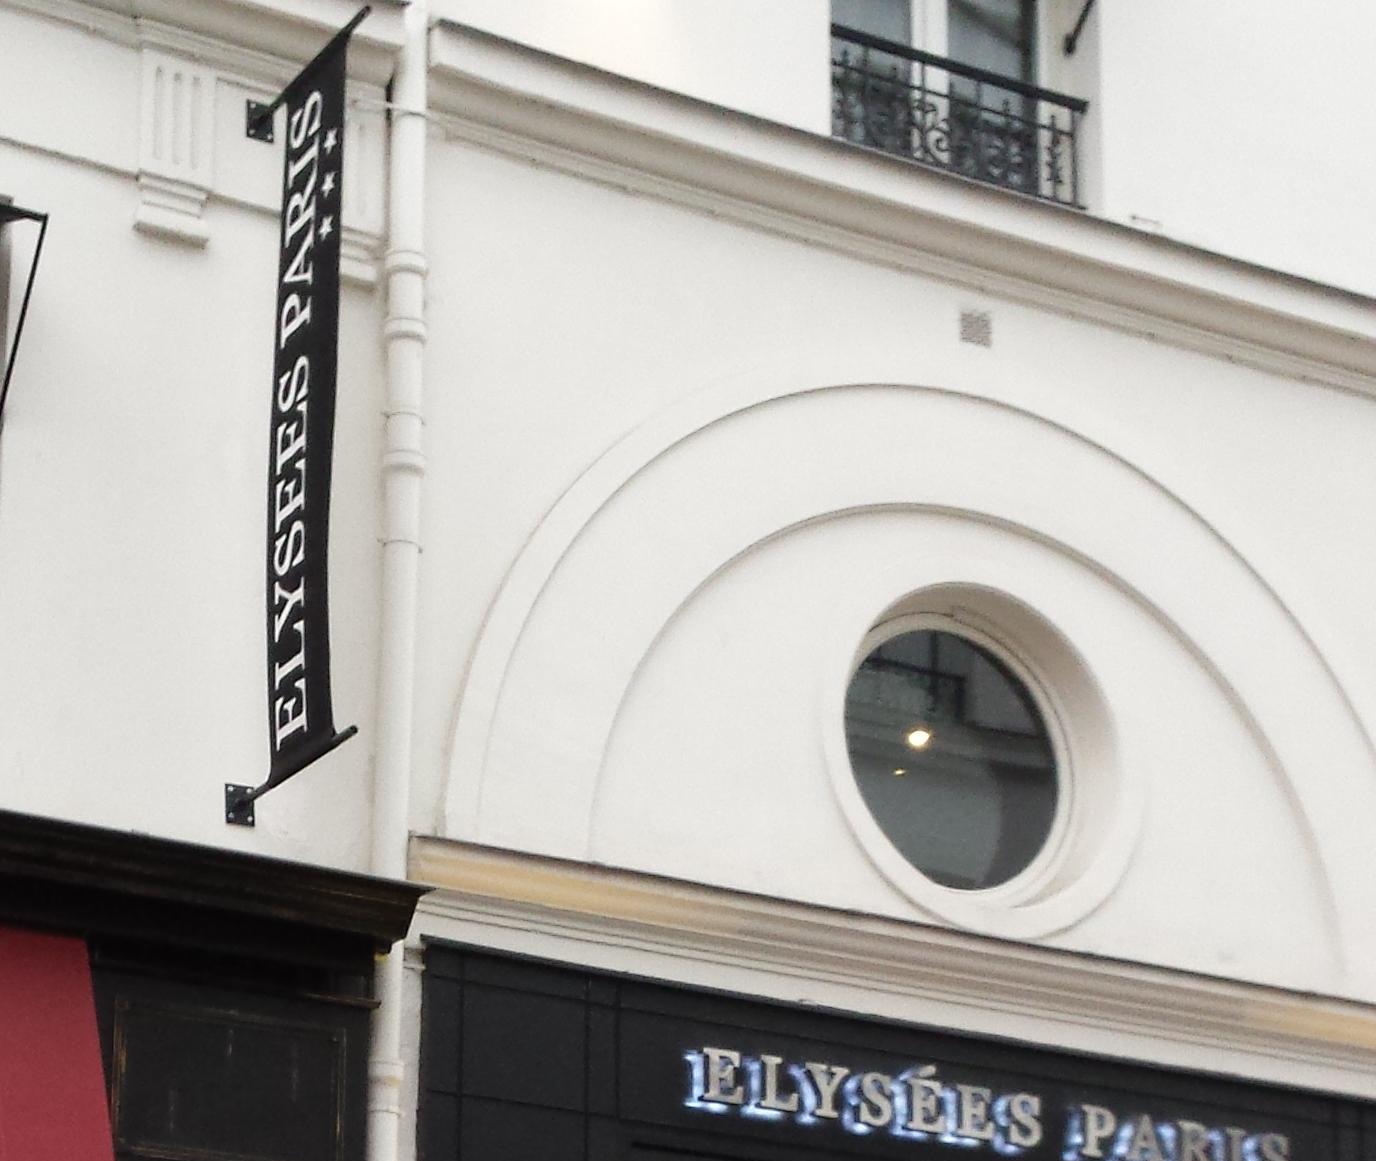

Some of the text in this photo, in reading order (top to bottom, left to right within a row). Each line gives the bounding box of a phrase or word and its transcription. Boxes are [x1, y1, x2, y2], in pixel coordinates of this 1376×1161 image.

[274, 90, 323, 750] ELYSEES PARIS
[685, 1047, 1043, 1153] ELYSÉES
